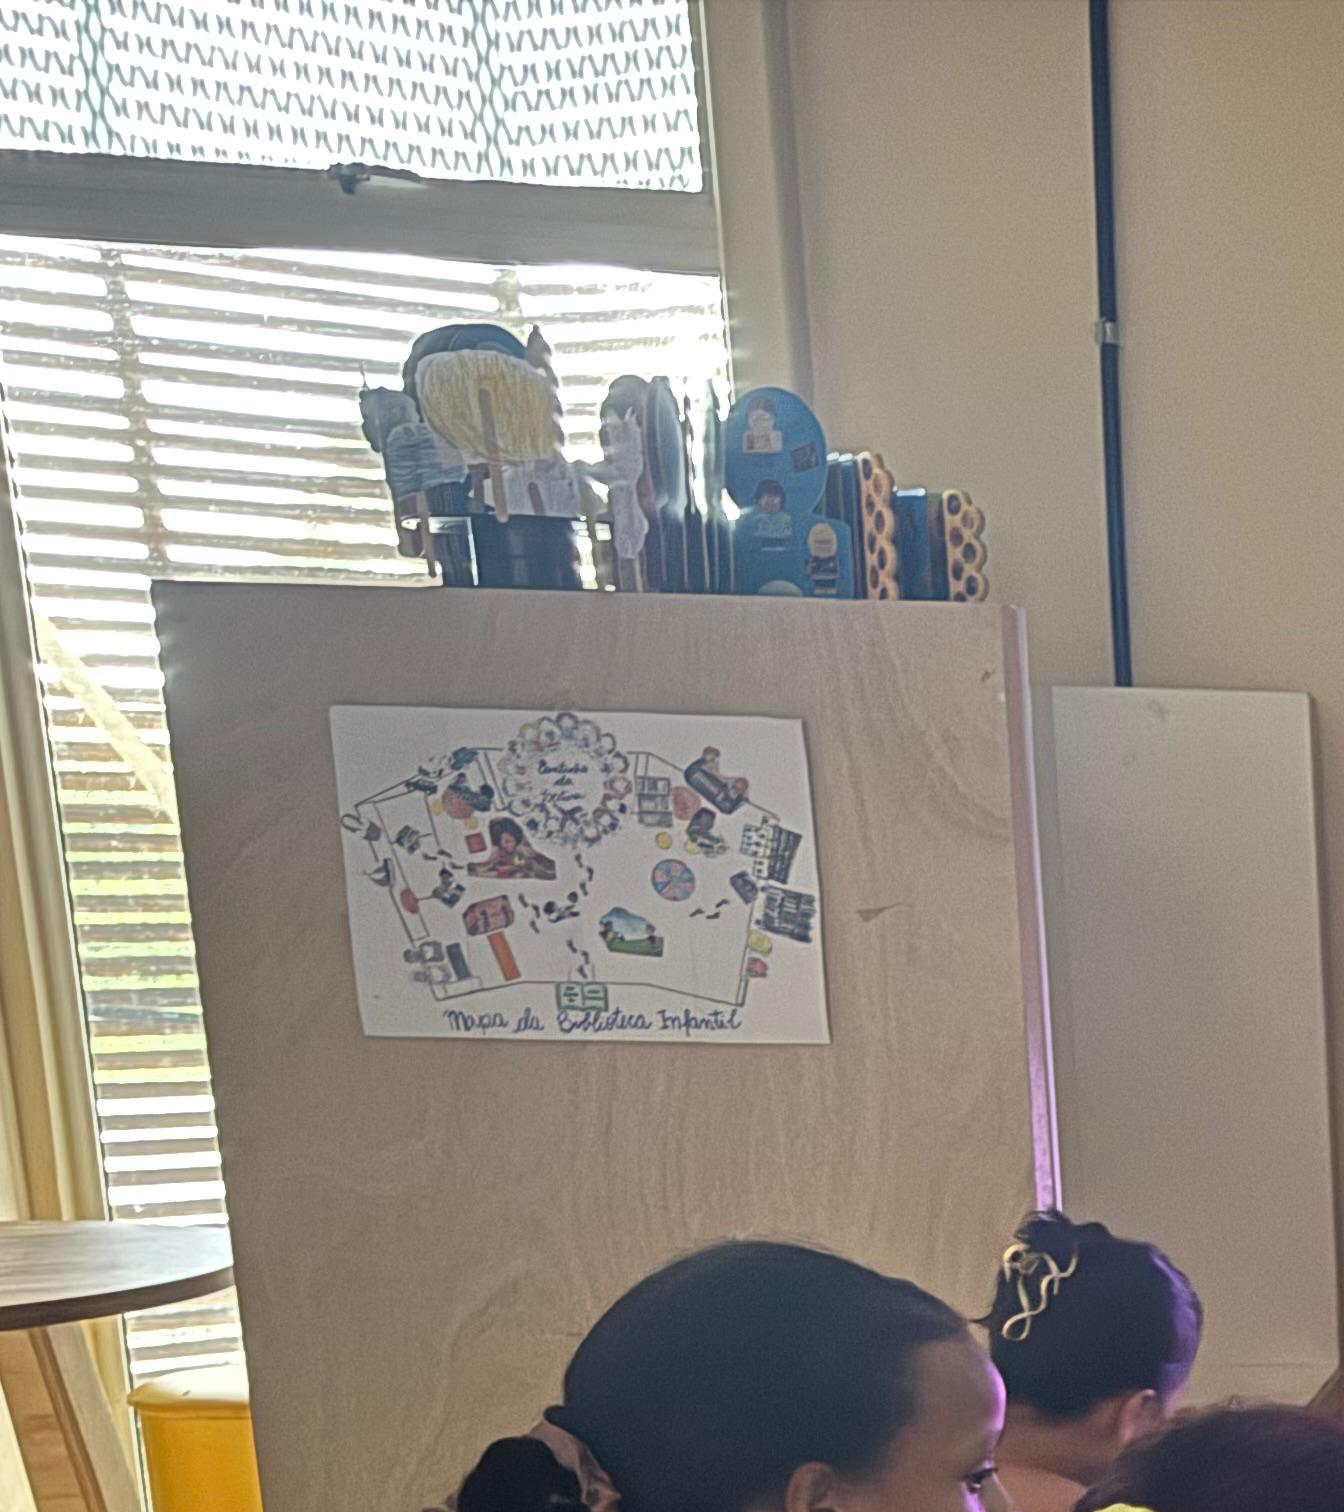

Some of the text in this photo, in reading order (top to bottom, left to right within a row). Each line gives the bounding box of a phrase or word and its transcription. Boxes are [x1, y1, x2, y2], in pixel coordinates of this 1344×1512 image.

[447, 1009, 508, 1035] Mapa
[556, 1007, 653, 1034] Biblioteca
[658, 1007, 742, 1037] Infantil
